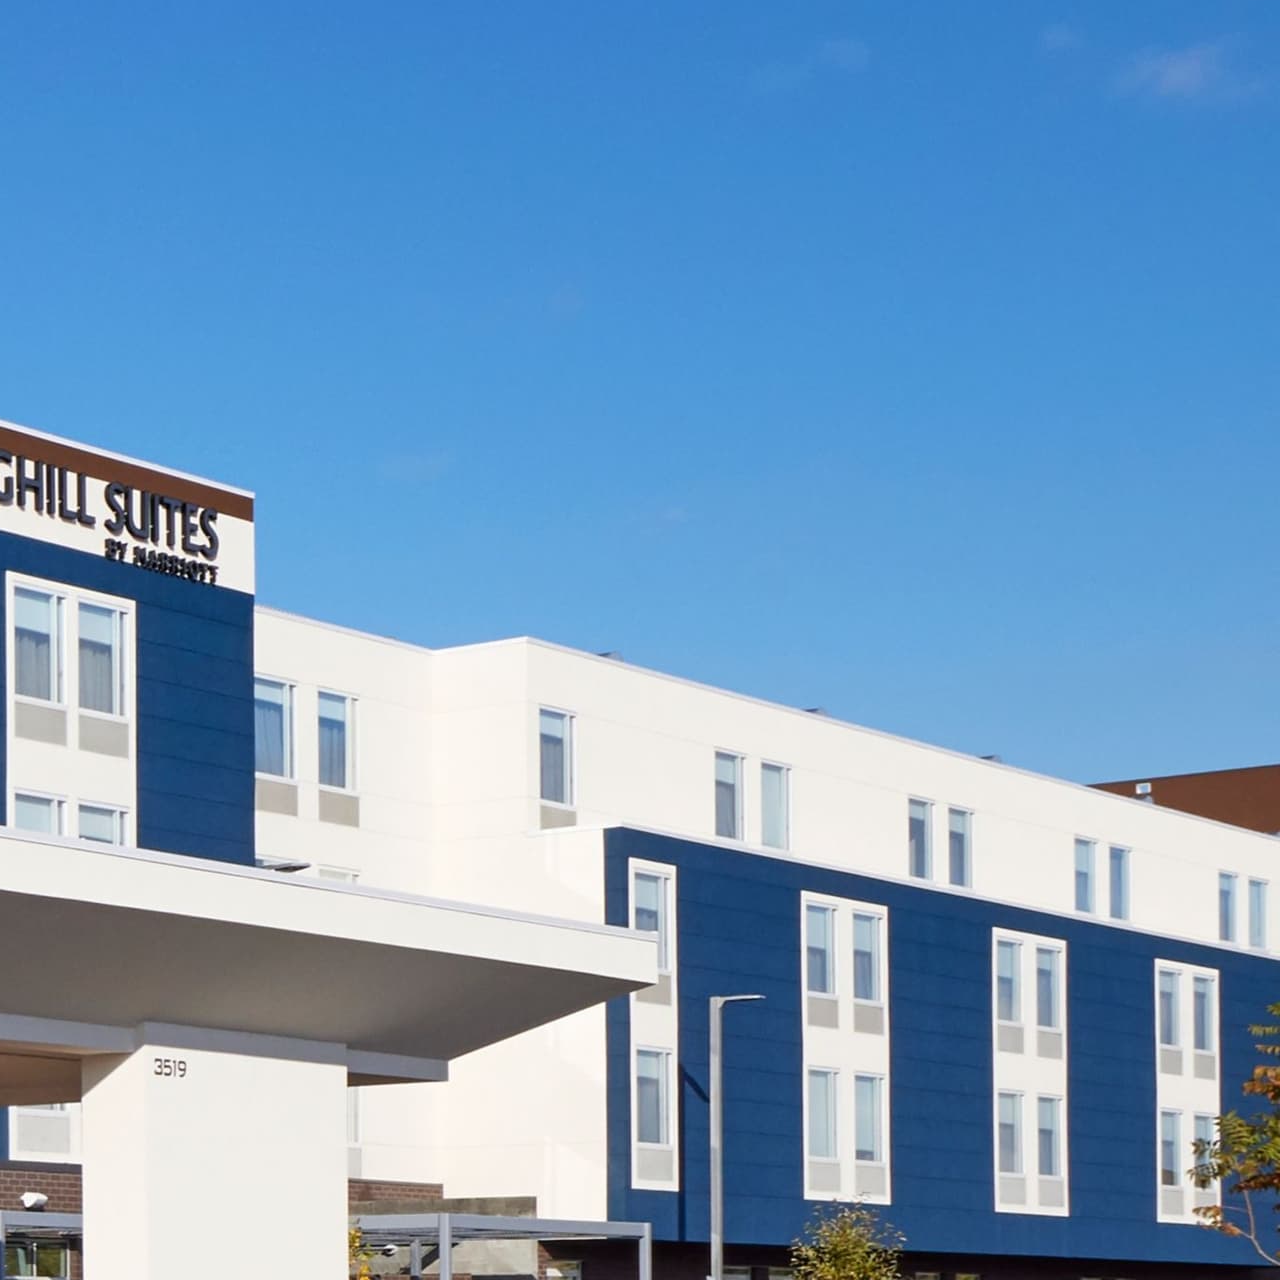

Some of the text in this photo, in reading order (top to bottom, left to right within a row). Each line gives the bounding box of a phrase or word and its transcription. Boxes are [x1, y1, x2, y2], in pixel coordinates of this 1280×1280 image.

[104, 482, 220, 561] SUITES
[104, 538, 220, 587] BY MARRIOTT
[154, 1057, 187, 1078] 3519
